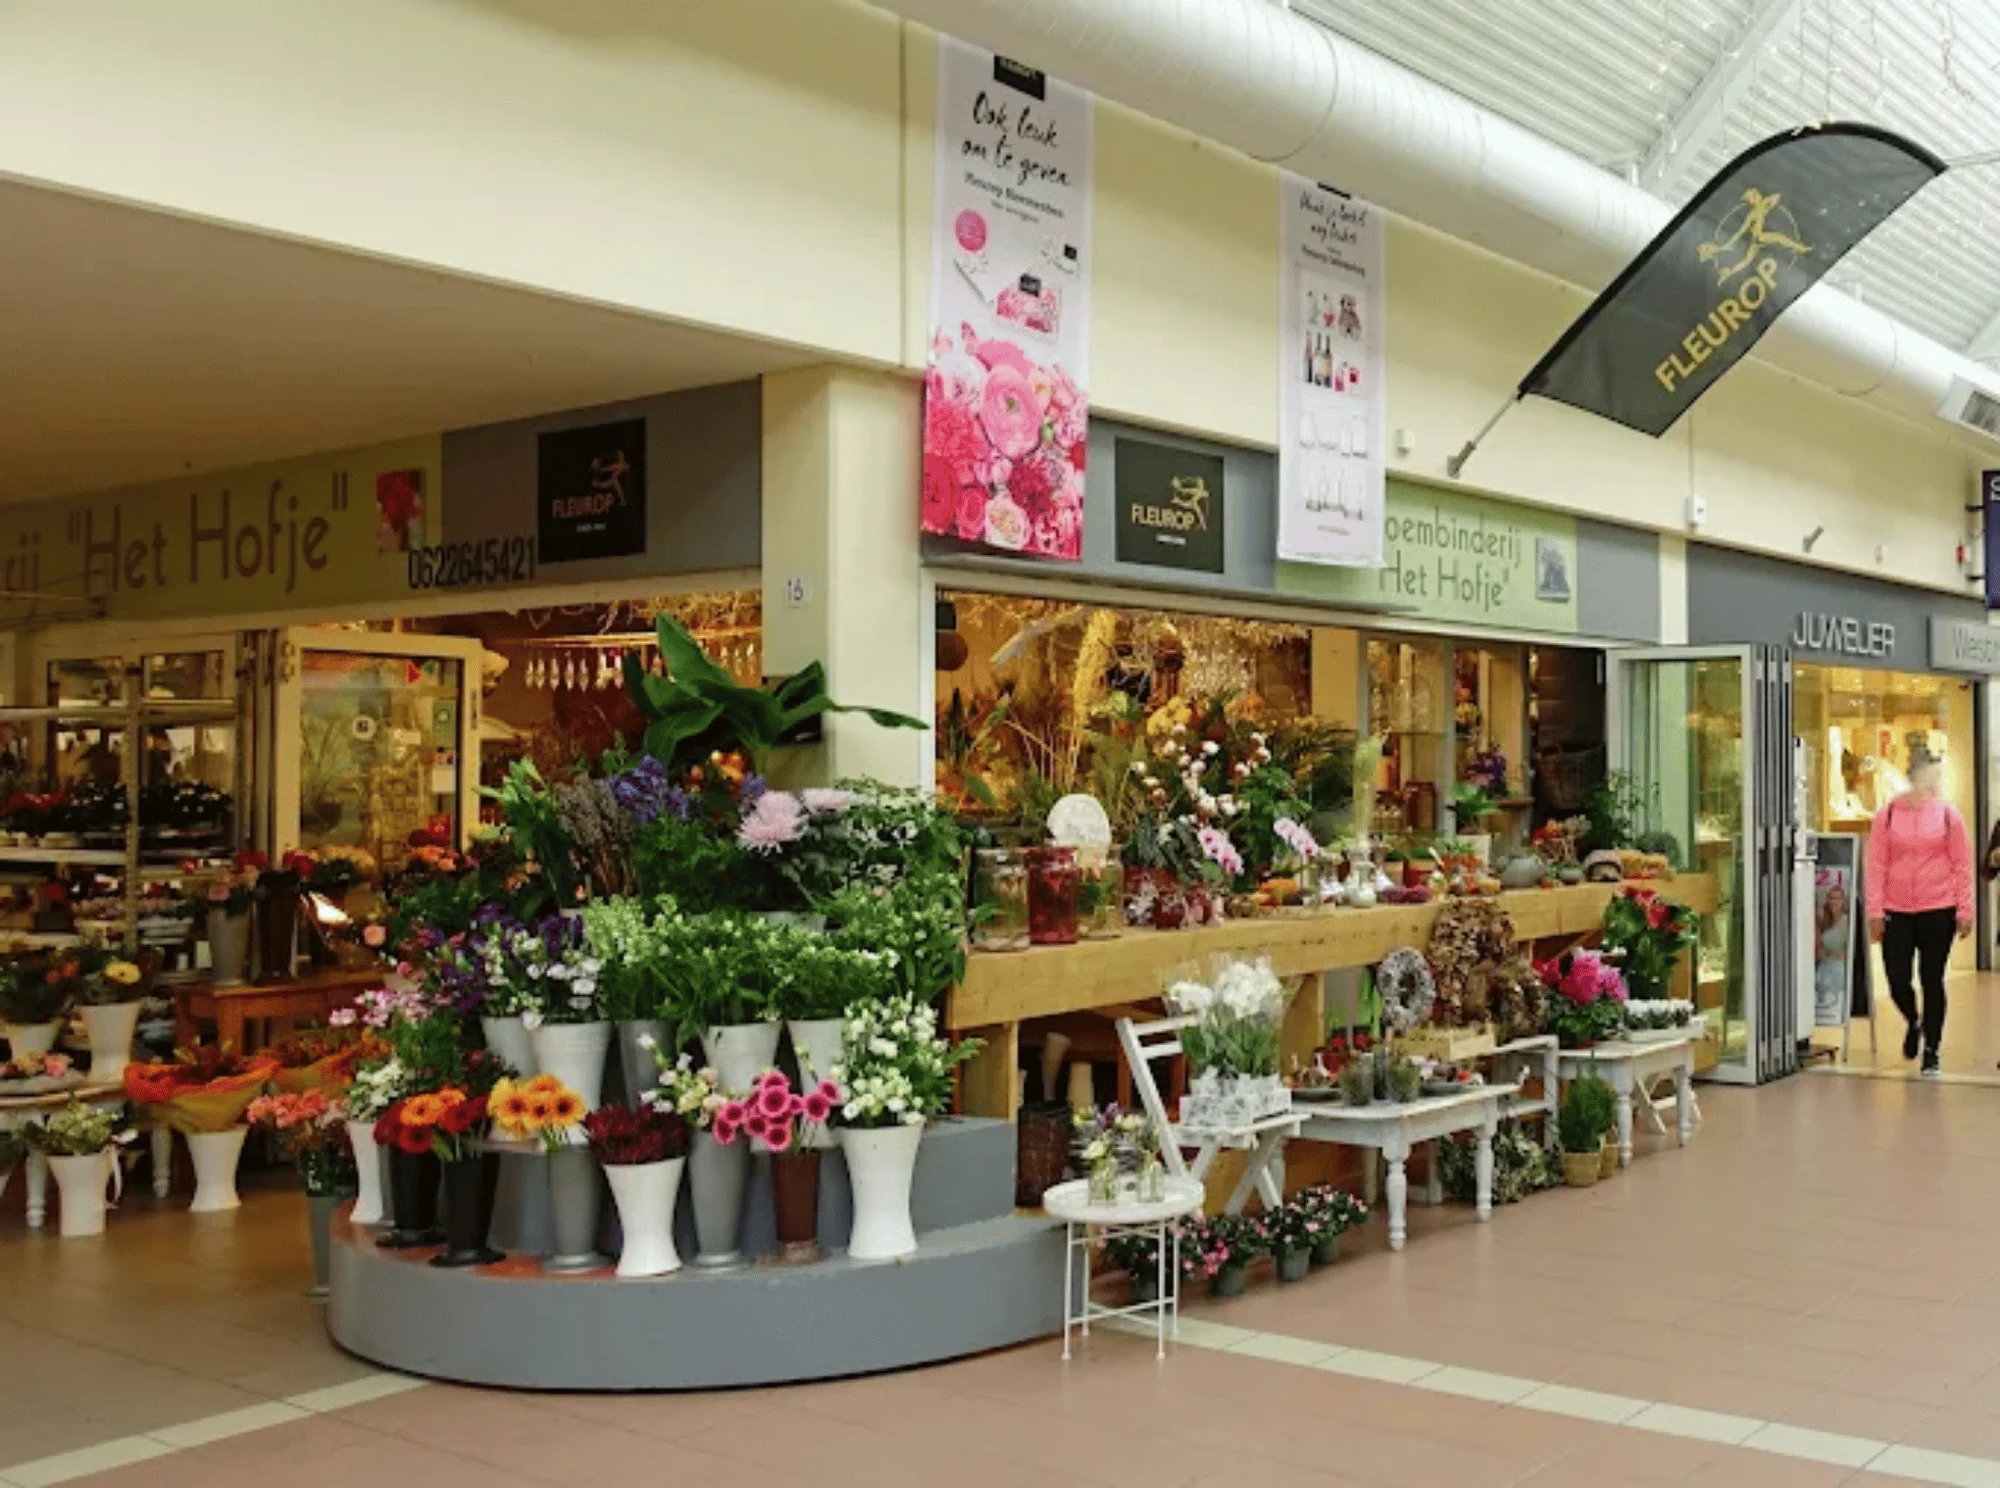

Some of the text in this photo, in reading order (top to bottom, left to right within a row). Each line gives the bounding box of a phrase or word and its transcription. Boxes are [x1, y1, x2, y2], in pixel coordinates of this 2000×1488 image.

[973, 91, 1058, 149] Ook leuk
[994, 134, 1014, 168] te
[1018, 158, 1071, 187] geven
[1655, 258, 1778, 392] FLEUROP
[552, 493, 616, 519] FLEUROP
[1130, 503, 1196, 531] FLEUROP
[67, 503, 168, 594] "Het
[190, 471, 349, 595] Hofje"
[1385, 504, 1522, 569] oembinderij
[407, 536, 537, 589] 0622645421
[1794, 611, 1895, 657] JUWELIER
